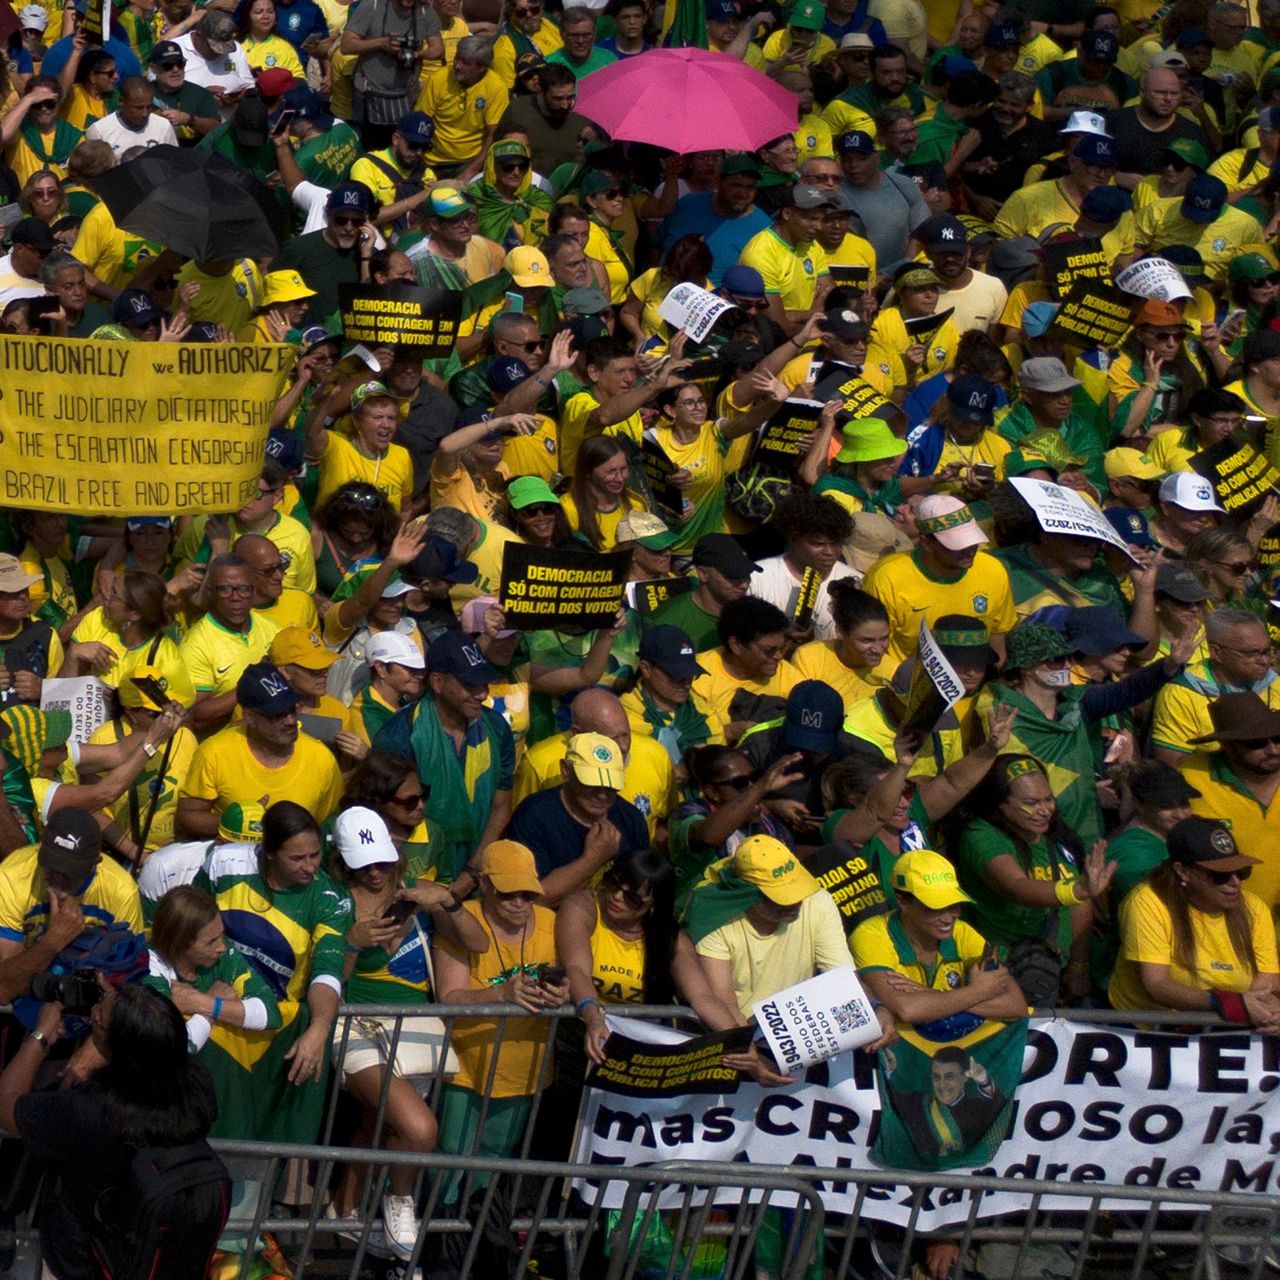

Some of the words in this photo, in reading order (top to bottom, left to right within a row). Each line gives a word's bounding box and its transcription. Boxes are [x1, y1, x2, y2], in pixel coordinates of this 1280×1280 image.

[152, 361, 174, 375] we
[16, 388, 44, 419] THE
[55, 394, 147, 424] JUDICIARY
[16, 431, 45, 459] THE
[55, 434, 157, 465] ESCALATION
[5, 470, 71, 505] BRAZIL
[77, 479, 122, 508] FREE
[135, 481, 169, 507] AND
[176, 481, 232, 508] GREAT
[527, 565, 613, 583] DEMOCRACIA
[508, 580, 526, 597] SÓ
[529, 584, 557, 599] COM
[560, 584, 622, 600] CONTAGEM
[504, 597, 555, 615] PÚBLICA
[559, 601, 583, 615] DOS
[461, 644, 486, 666] M
[358, 828, 375, 845] NY
[600, 964, 632, 978] MADE
[594, 1104, 736, 1148] mas
[1124, 1158, 1201, 1189] de
